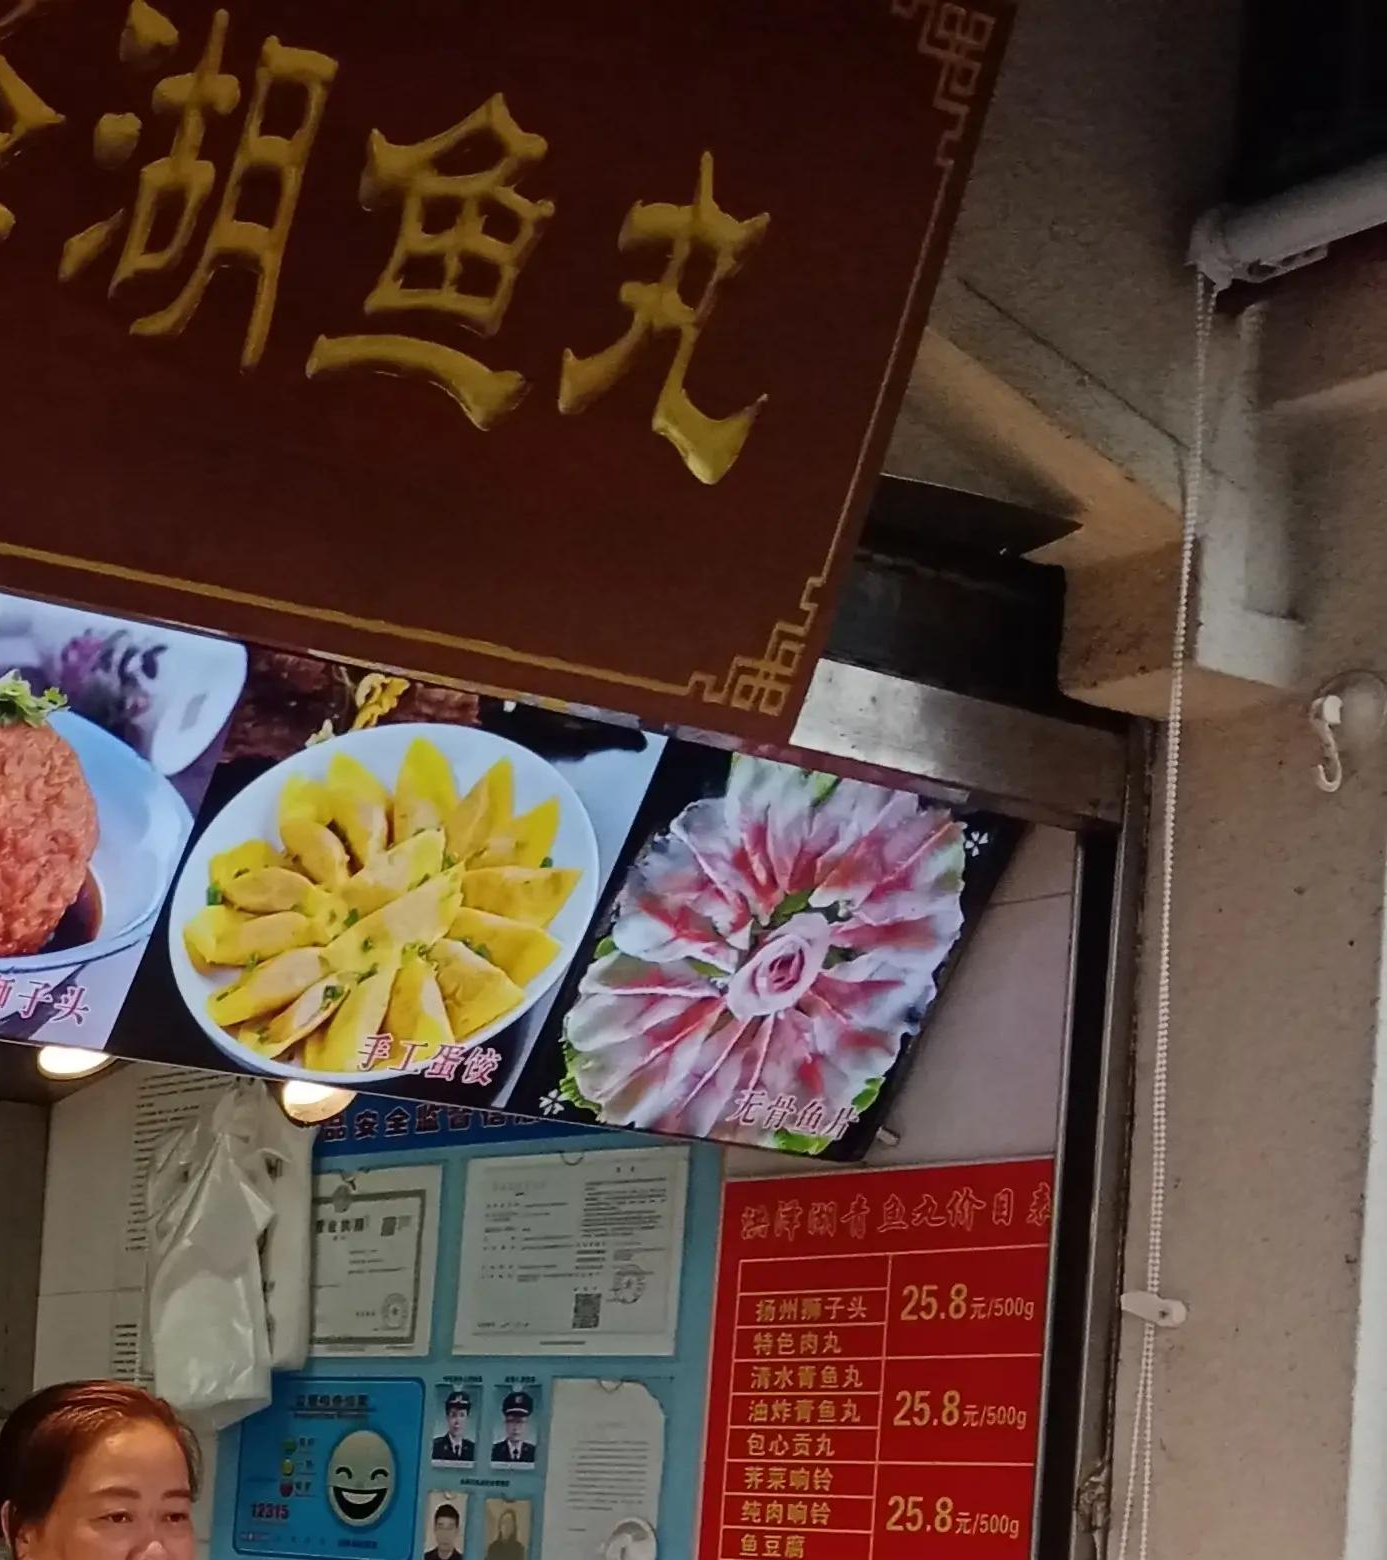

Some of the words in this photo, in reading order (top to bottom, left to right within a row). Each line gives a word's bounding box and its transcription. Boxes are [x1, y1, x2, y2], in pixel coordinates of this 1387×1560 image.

[355, 1031, 503, 1088] 手工蛋饺
[725, 1087, 861, 1142] 无骨鱼片
[754, 1297, 868, 1323] 扬州狮子头
[900, 1283, 1036, 1322] 25.8元/500g
[752, 1332, 843, 1356] 特色肉丸
[749, 1365, 864, 1391] 清水青鱼丸
[747, 1397, 862, 1425] 油炸青鱼丸
[892, 1390, 1028, 1431] 25.8元/500g
[745, 1432, 836, 1458] 包心贡丸
[743, 1466, 835, 1492] 荠菜响铃
[250, 1501, 290, 1520] 12315
[740, 1500, 832, 1526] 纯肉响铃
[885, 1494, 1021, 1540] 25.8元/500g
[738, 1533, 806, 1560] 鱼豆腐
